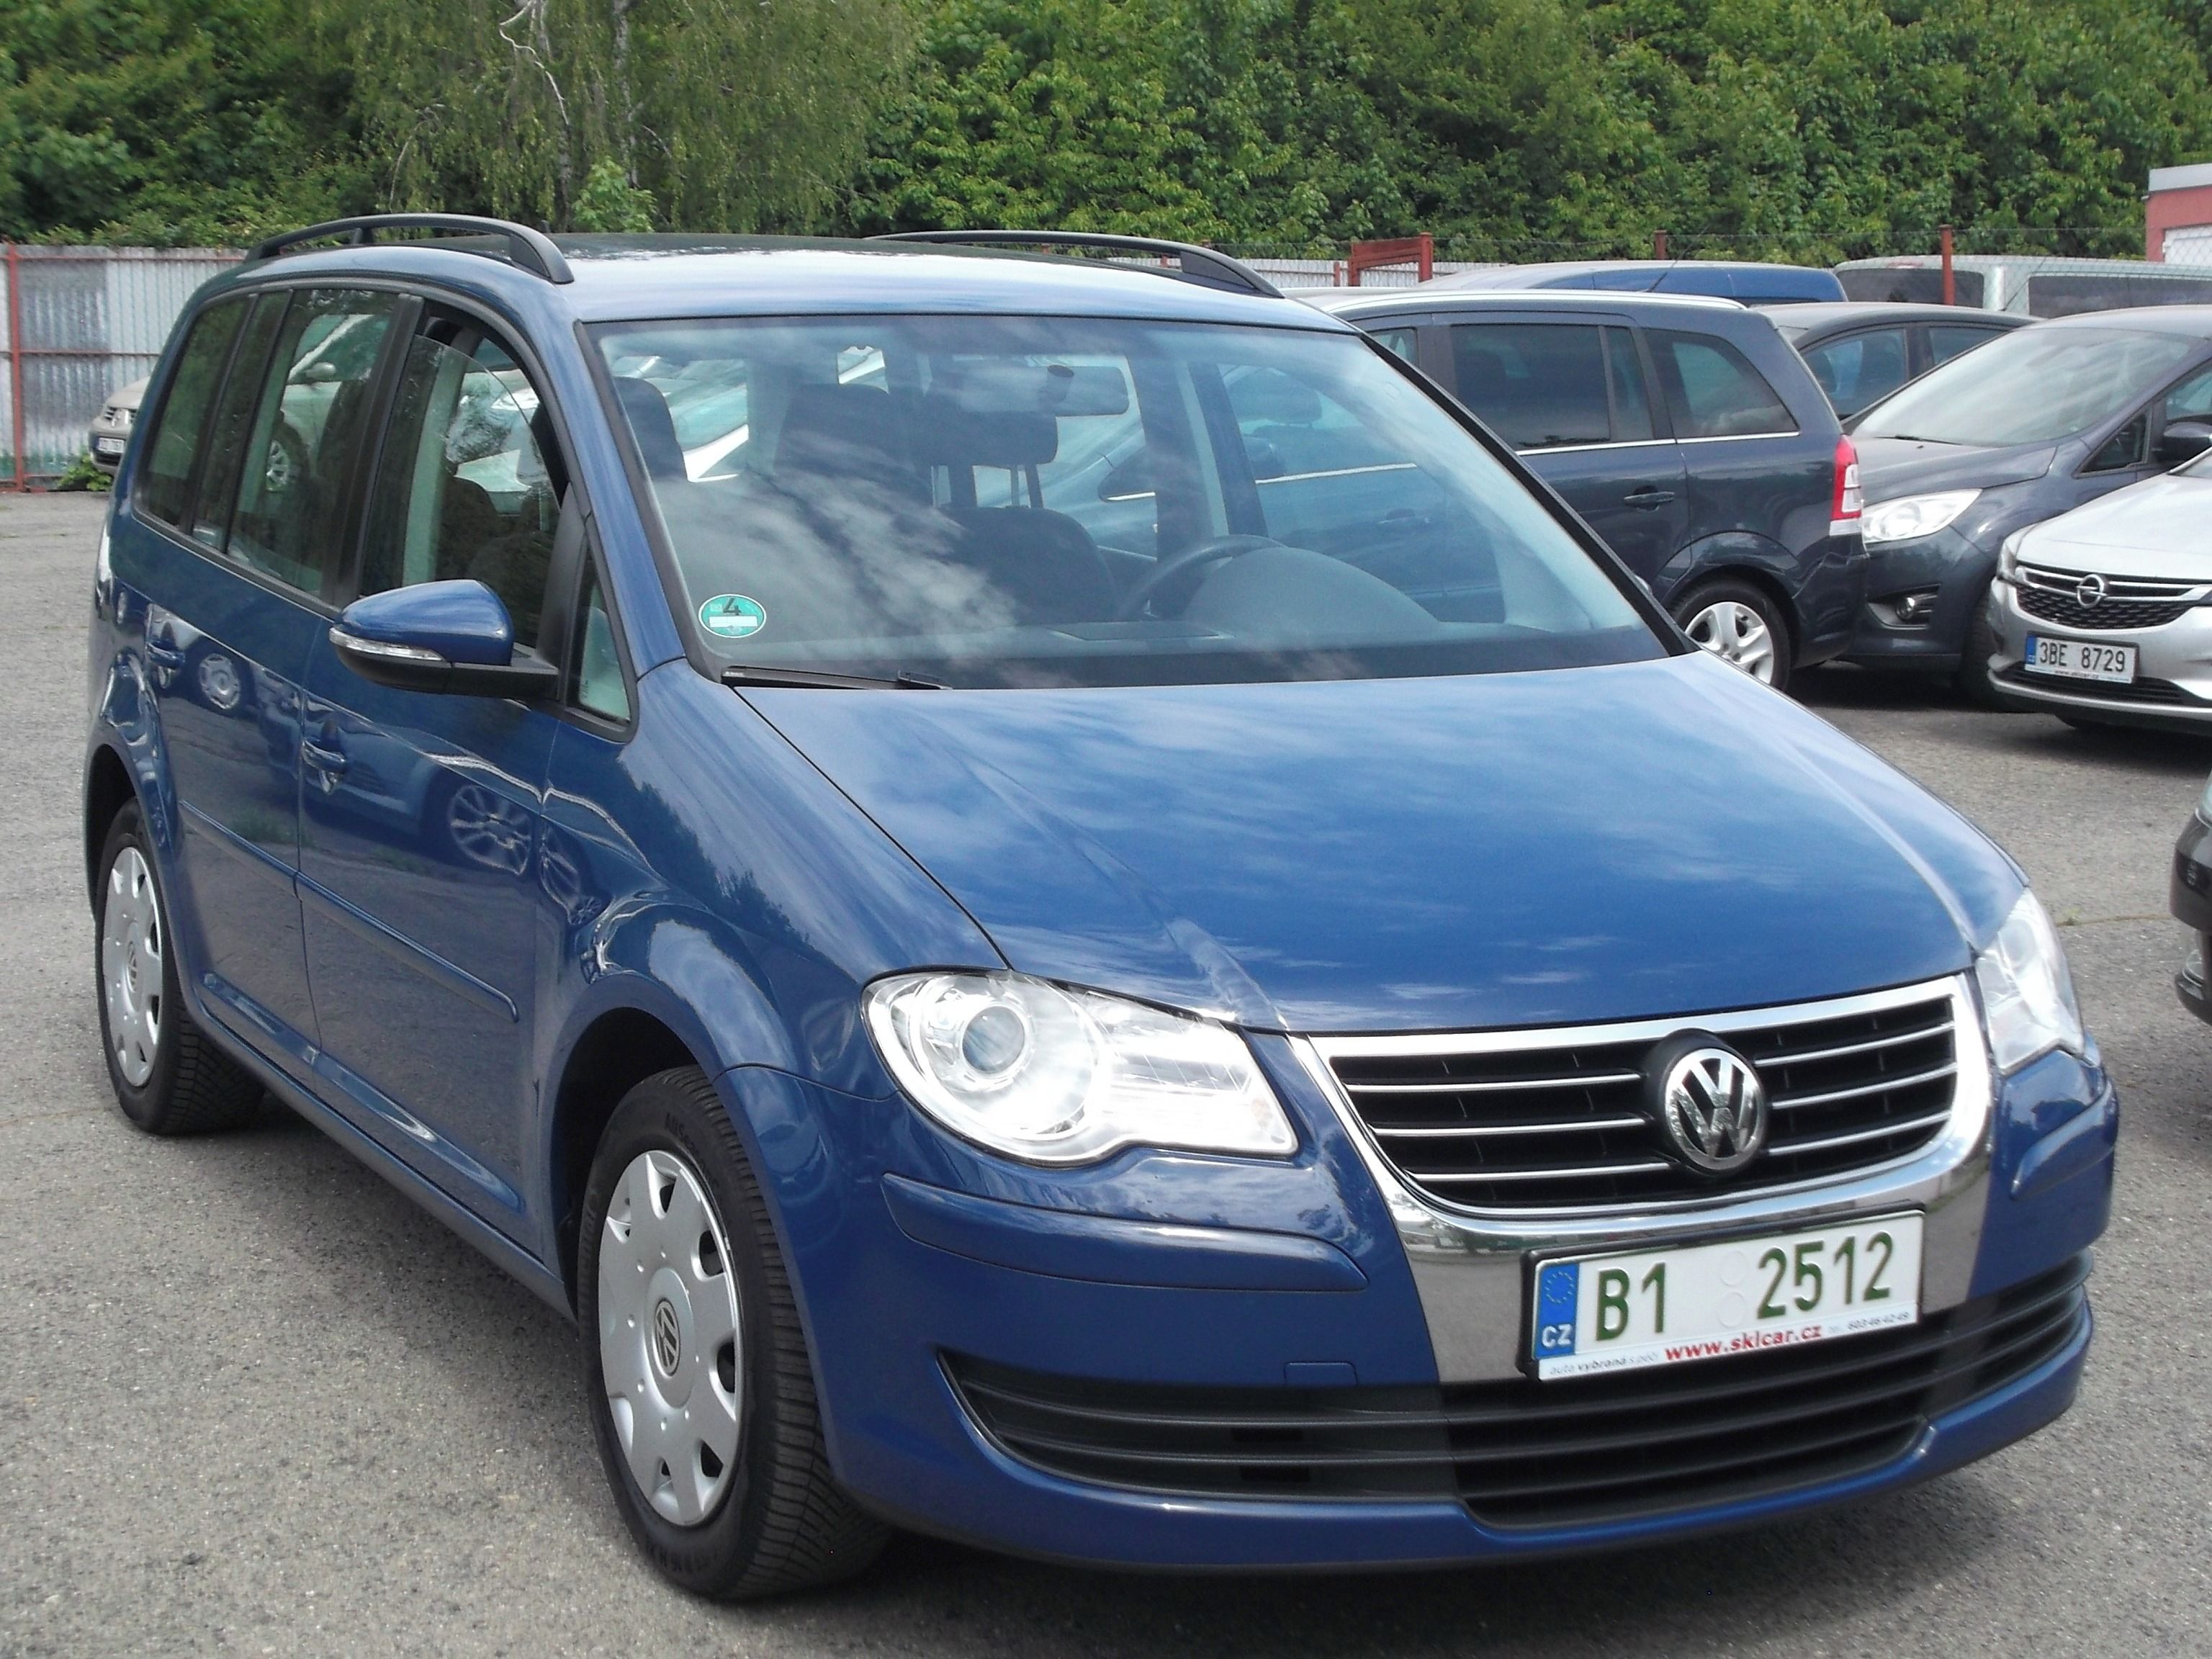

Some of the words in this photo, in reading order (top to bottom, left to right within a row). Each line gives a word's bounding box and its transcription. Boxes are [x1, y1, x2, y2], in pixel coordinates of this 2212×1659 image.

[723, 597, 742, 616] 4
[2039, 642, 2067, 667] 3BE
[2081, 647, 2125, 673] 8729
[1596, 1262, 1666, 1341] B1
[1757, 1231, 1893, 1319] 2512
[1542, 1323, 1573, 1348] CZ
